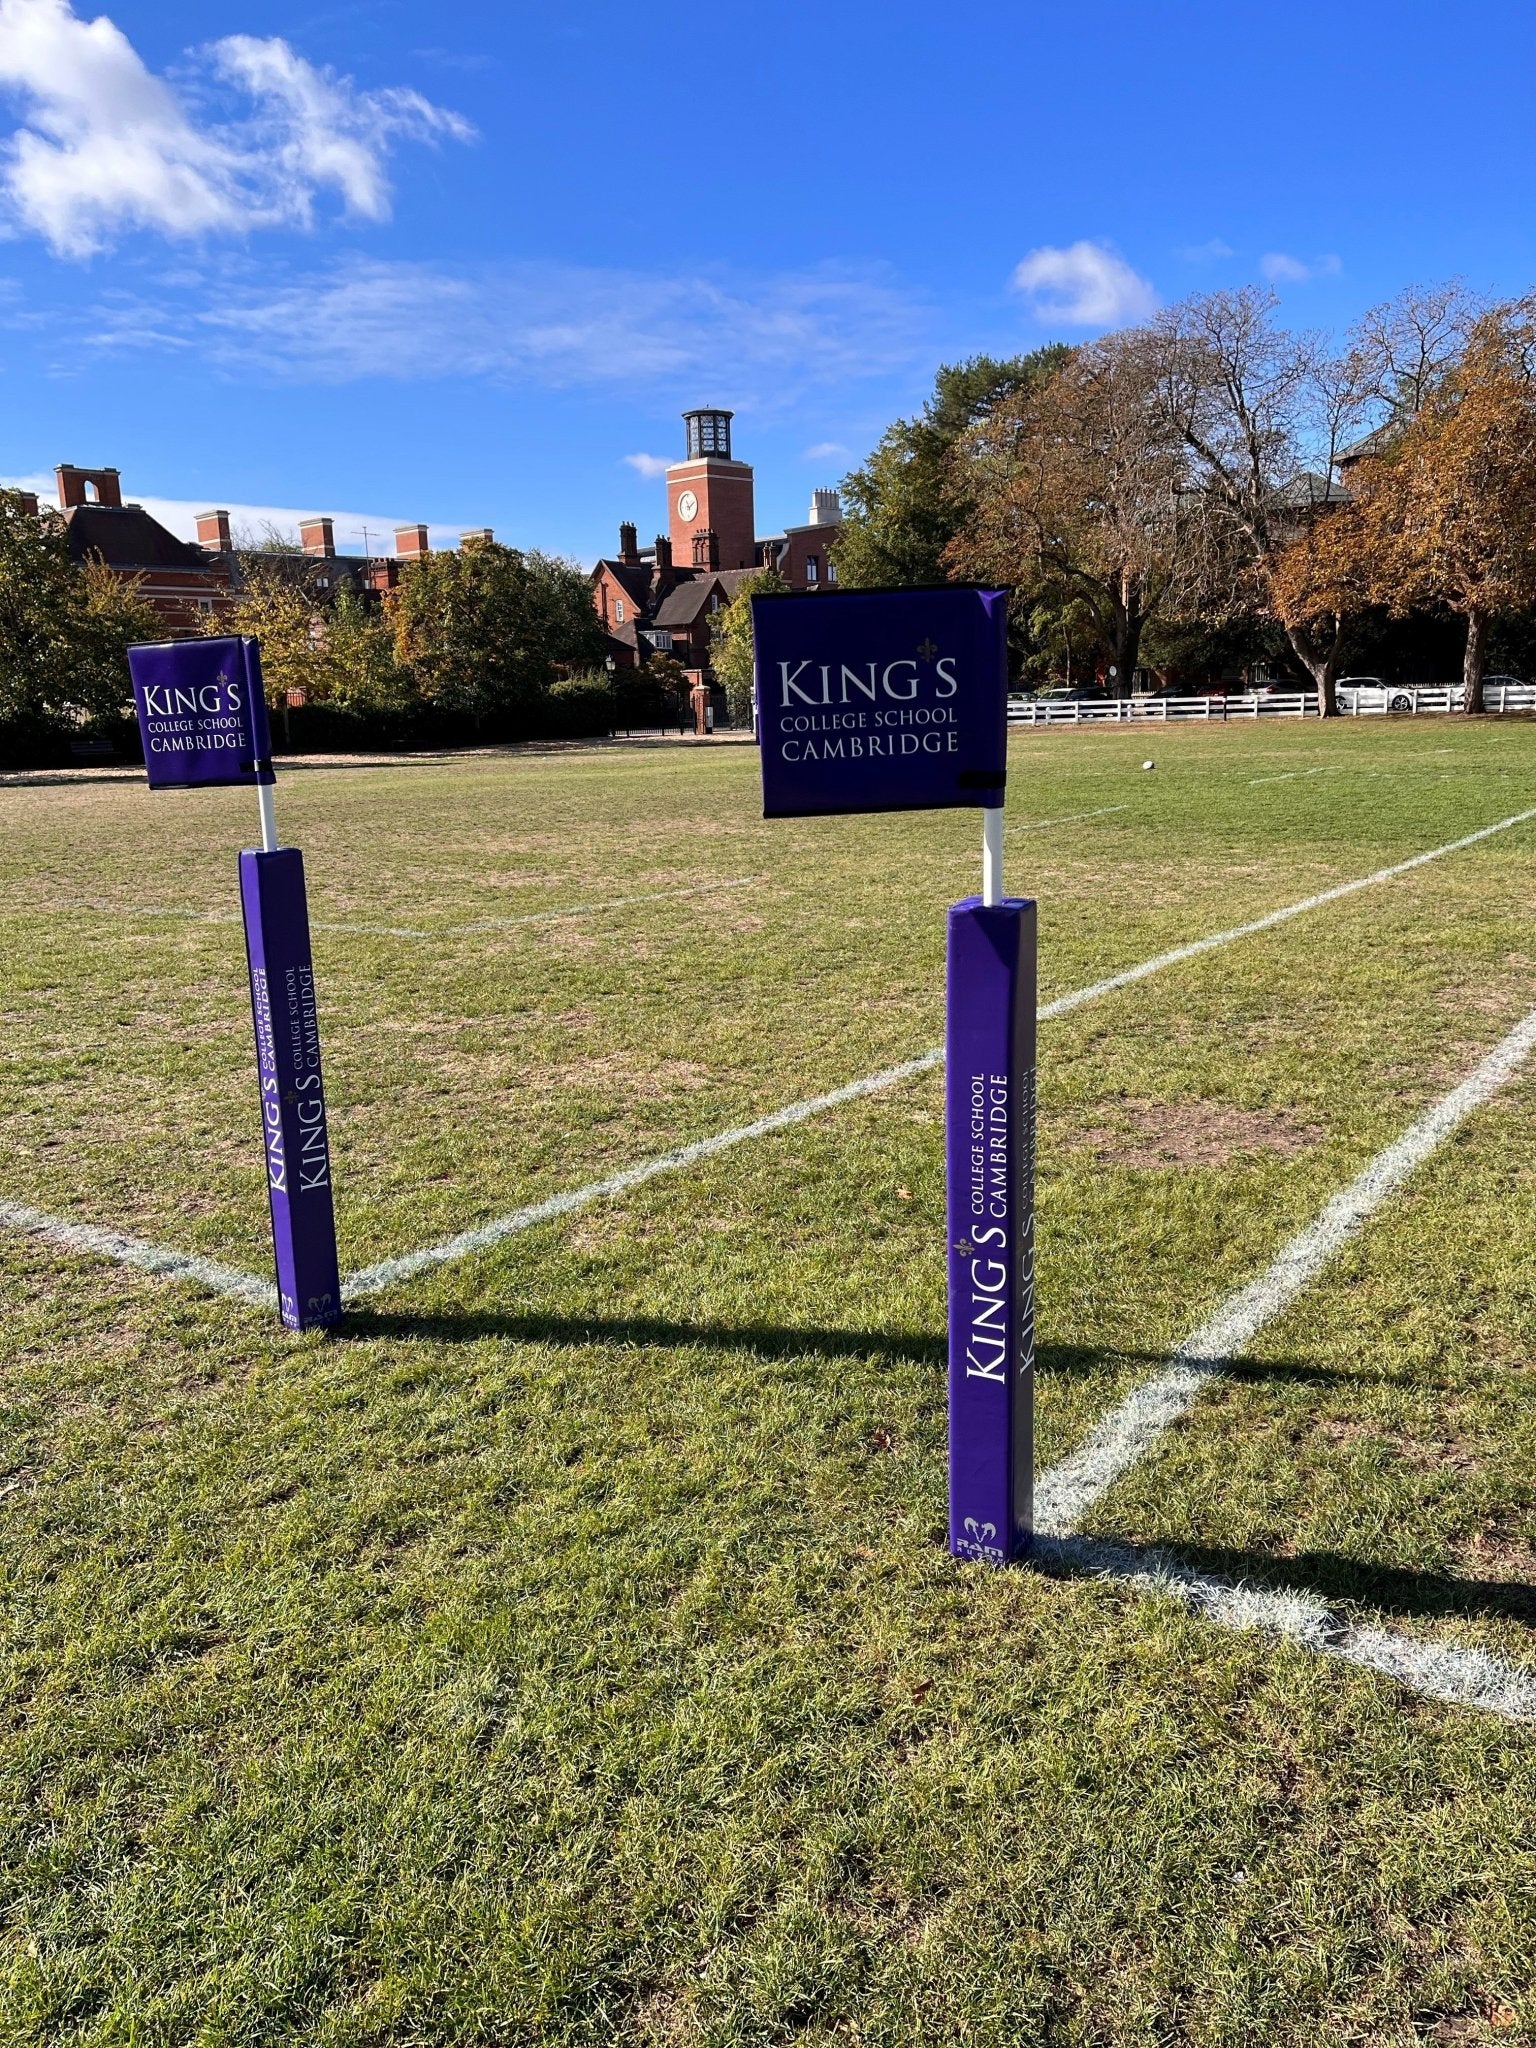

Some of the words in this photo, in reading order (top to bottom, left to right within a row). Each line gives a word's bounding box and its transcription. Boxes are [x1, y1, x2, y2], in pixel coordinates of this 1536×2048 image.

[147, 720, 195, 733] COLLEGE
[197, 716, 243, 731] SCHOOL
[150, 732, 247, 753] CAMBRIDGE
[780, 712, 867, 733] COLLEGE
[874, 707, 958, 727] SCHOOL
[781, 731, 959, 762] CAMBRIDGE
[253, 967, 263, 1016] SCHOOL
[285, 966, 299, 1016] SCHOOL
[298, 964, 319, 1068] CAMBRIDGE
[257, 1019, 268, 1070] COLLEGE
[259, 968, 276, 1072] CAMBRIDGE
[290, 1018, 303, 1070] COLLEGE
[971, 1072, 984, 1140] SCHOOL
[990, 1074, 1007, 1218] CAMBRIDGE
[971, 1145, 984, 1215] COLLEGE
[956, 1537, 1004, 1558] RAM
